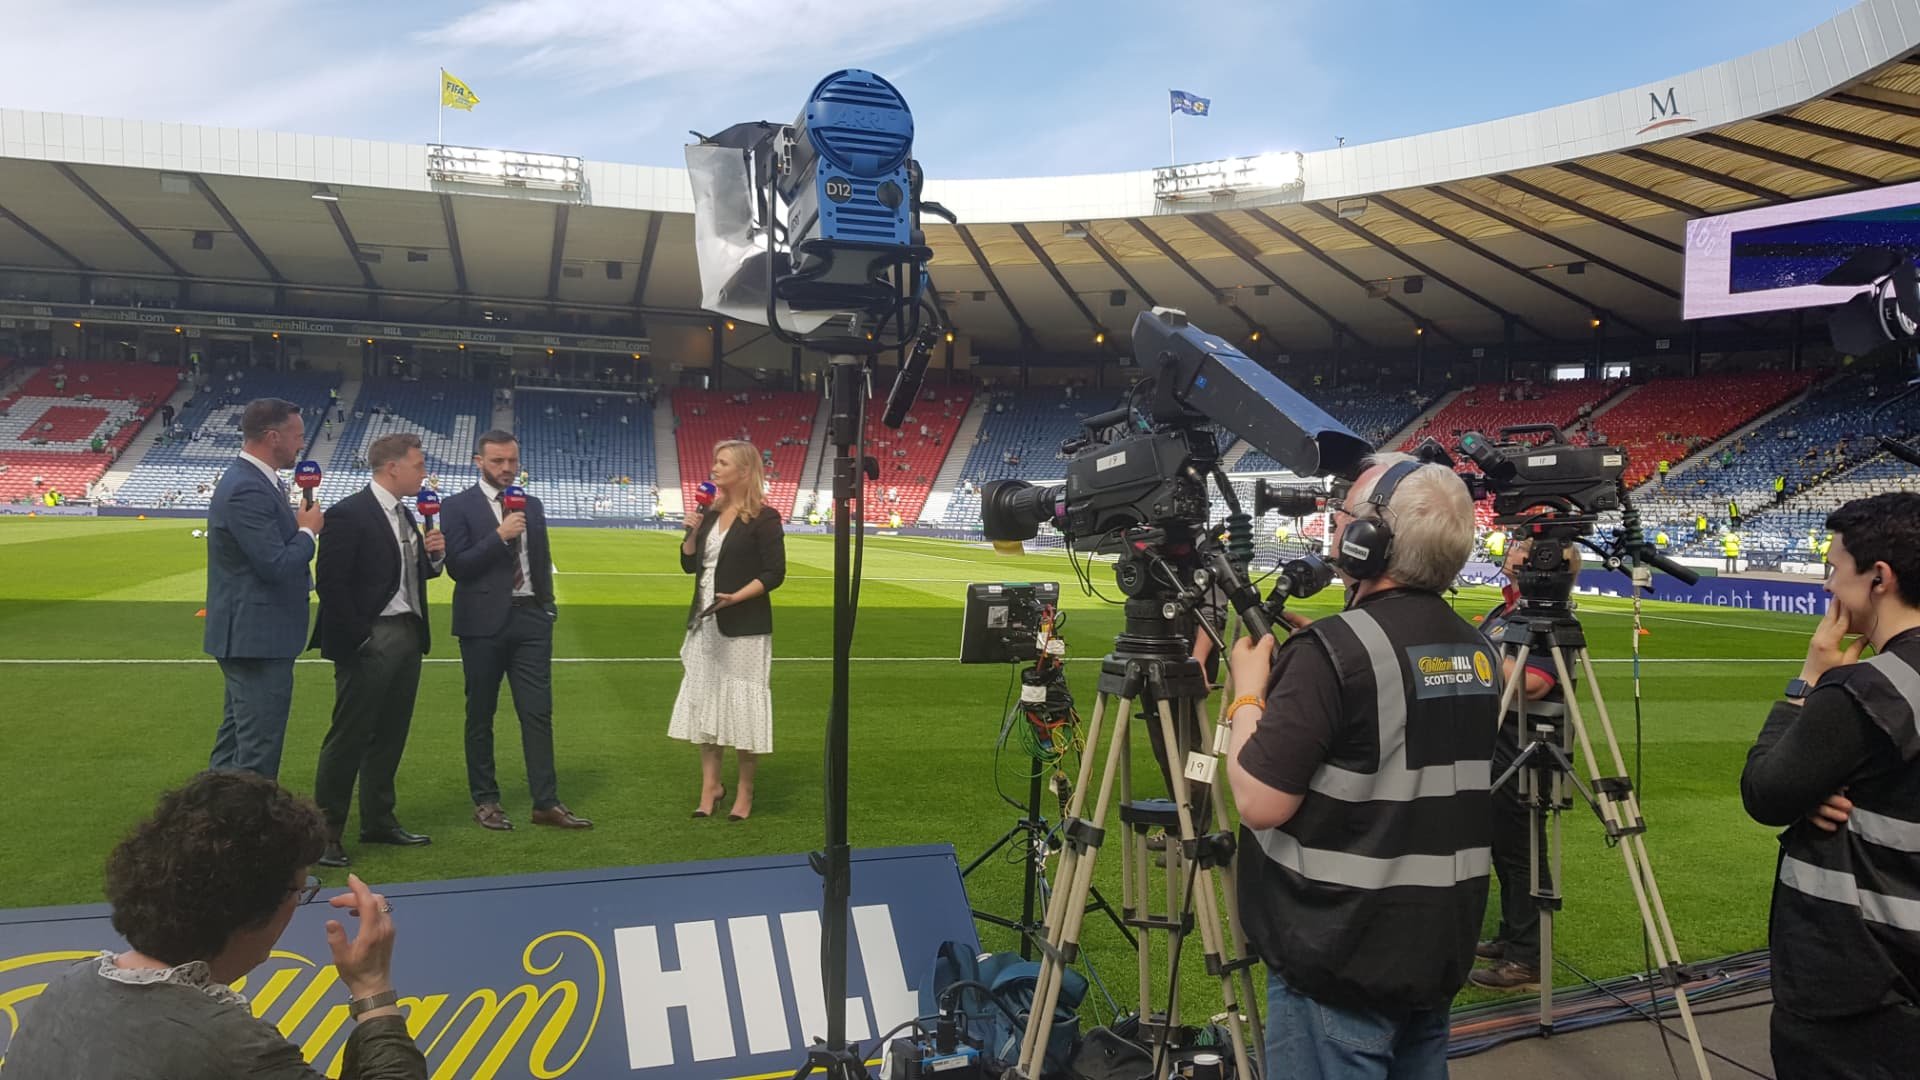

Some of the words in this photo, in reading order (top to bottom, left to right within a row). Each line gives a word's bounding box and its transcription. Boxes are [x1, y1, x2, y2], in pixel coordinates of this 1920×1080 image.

[1649, 87, 1680, 121] M
[826, 182, 851, 198] D12
[253, 319, 333, 333] williamhill.com
[1703, 589, 1753, 609] debt
[1763, 590, 1817, 615] trust
[1452, 655, 1472, 670] HILL
[1456, 673, 1473, 684] CUP
[1191, 760, 1204, 775] 19
[613, 903, 920, 1070] HILL
